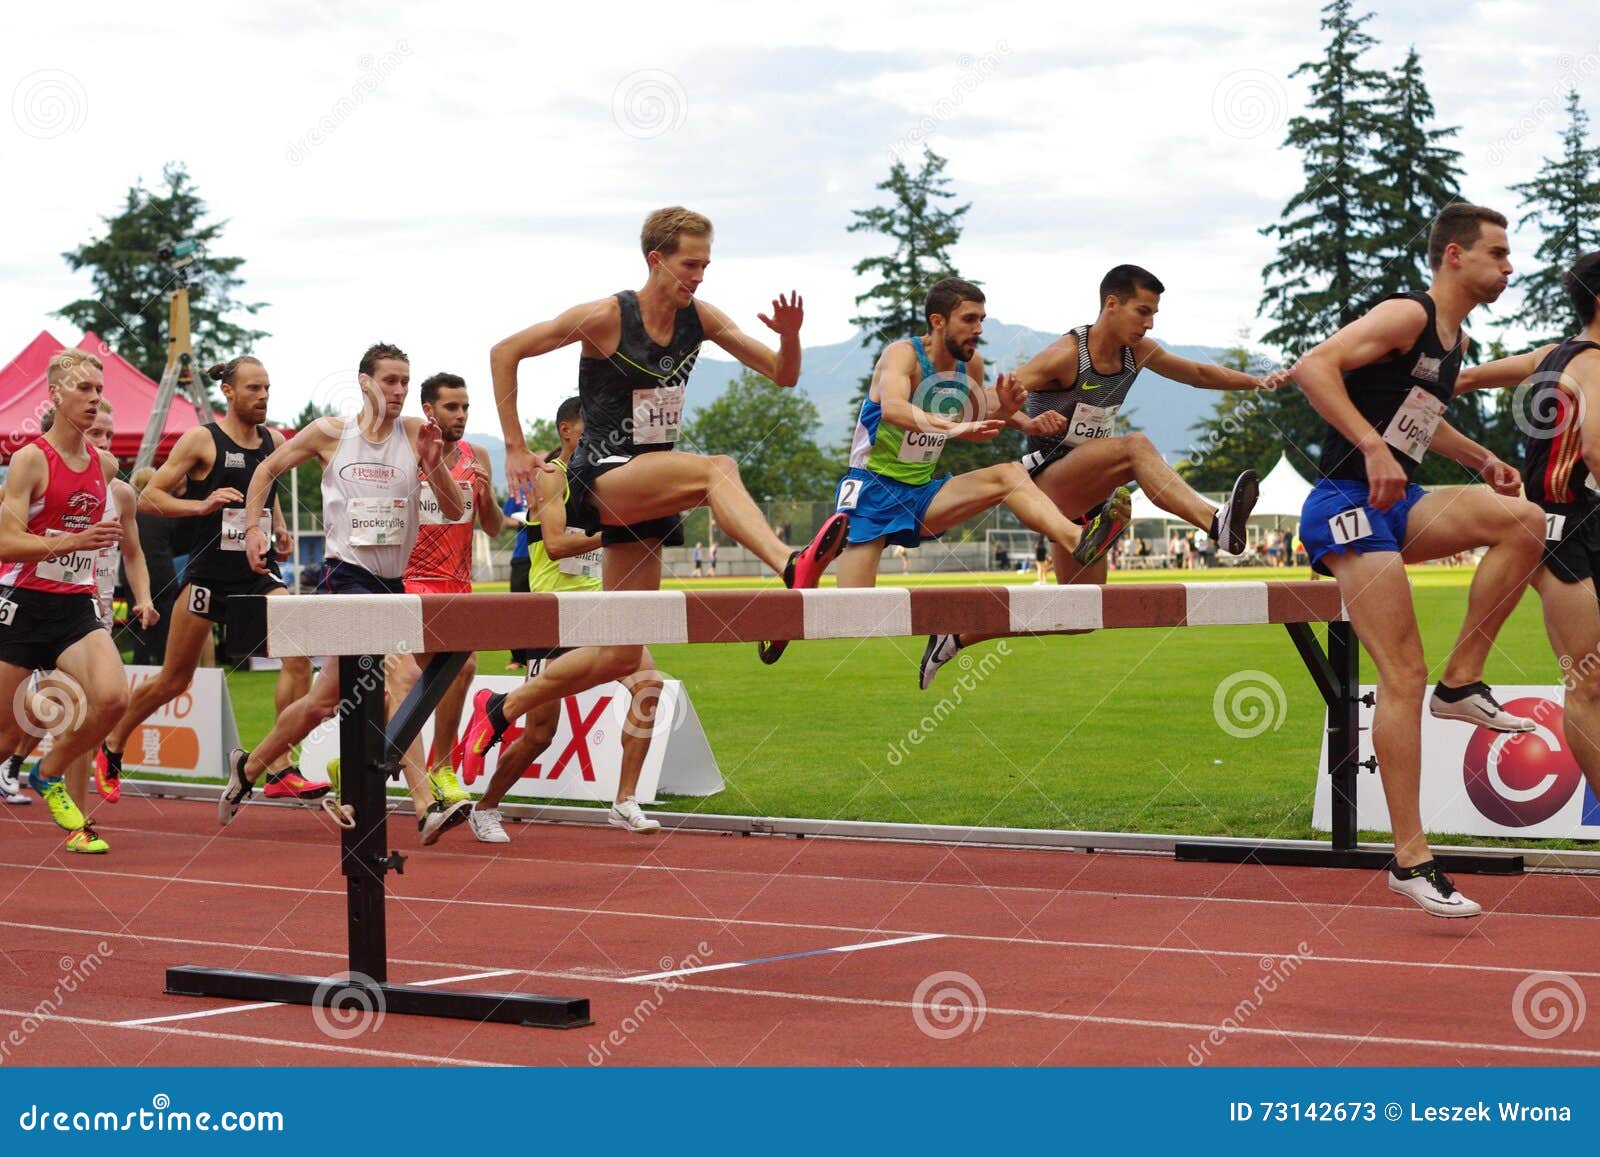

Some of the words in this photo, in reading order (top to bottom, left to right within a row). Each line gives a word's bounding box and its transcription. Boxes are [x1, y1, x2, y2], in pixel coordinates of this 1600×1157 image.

[650, 408, 678, 426] Hu
[840, 481, 855, 506] 2
[351, 517, 405, 529] Brockerville
[1335, 511, 1359, 541] 17
[193, 589, 206, 611] 8
[1487, 727, 1561, 802] C
